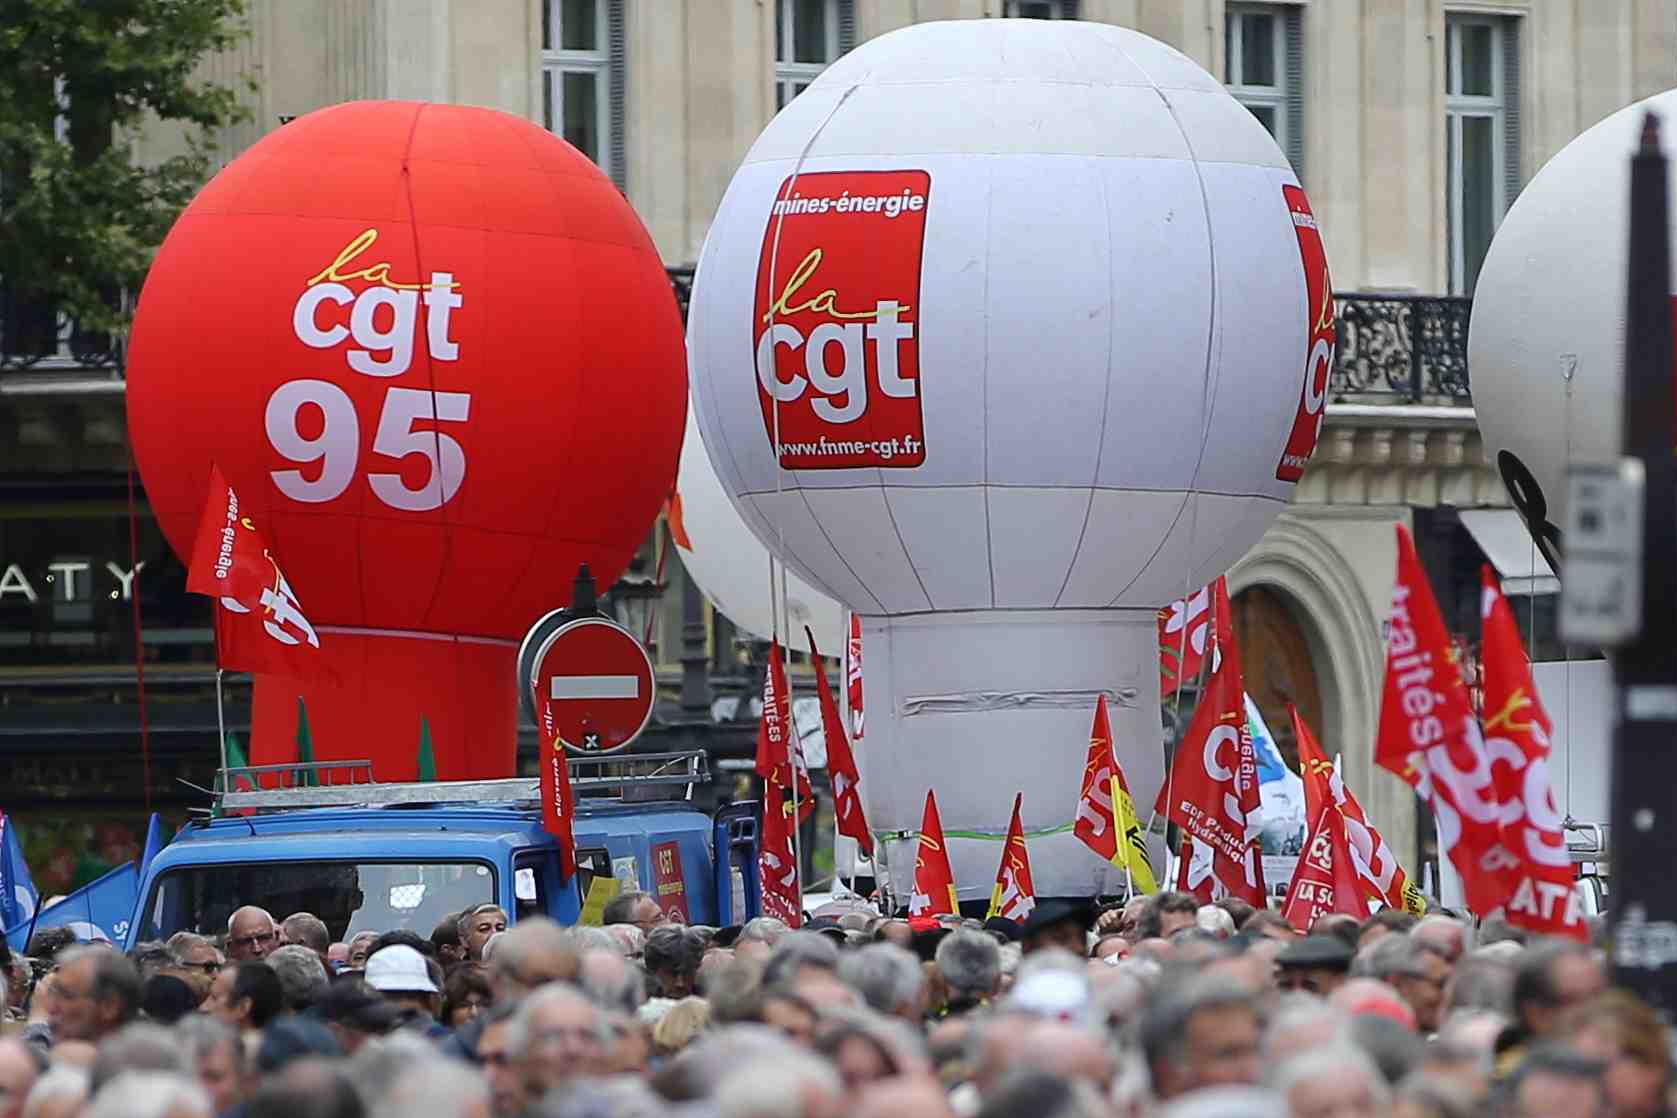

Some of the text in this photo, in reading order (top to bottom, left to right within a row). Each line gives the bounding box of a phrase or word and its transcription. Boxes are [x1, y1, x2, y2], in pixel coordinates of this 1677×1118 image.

[773, 189, 925, 218] mines-énergie
[293, 272, 463, 377] cgt
[757, 300, 917, 424] cgt
[264, 378, 471, 511] 95
[778, 435, 921, 459] www.fnme-cgt.fr
